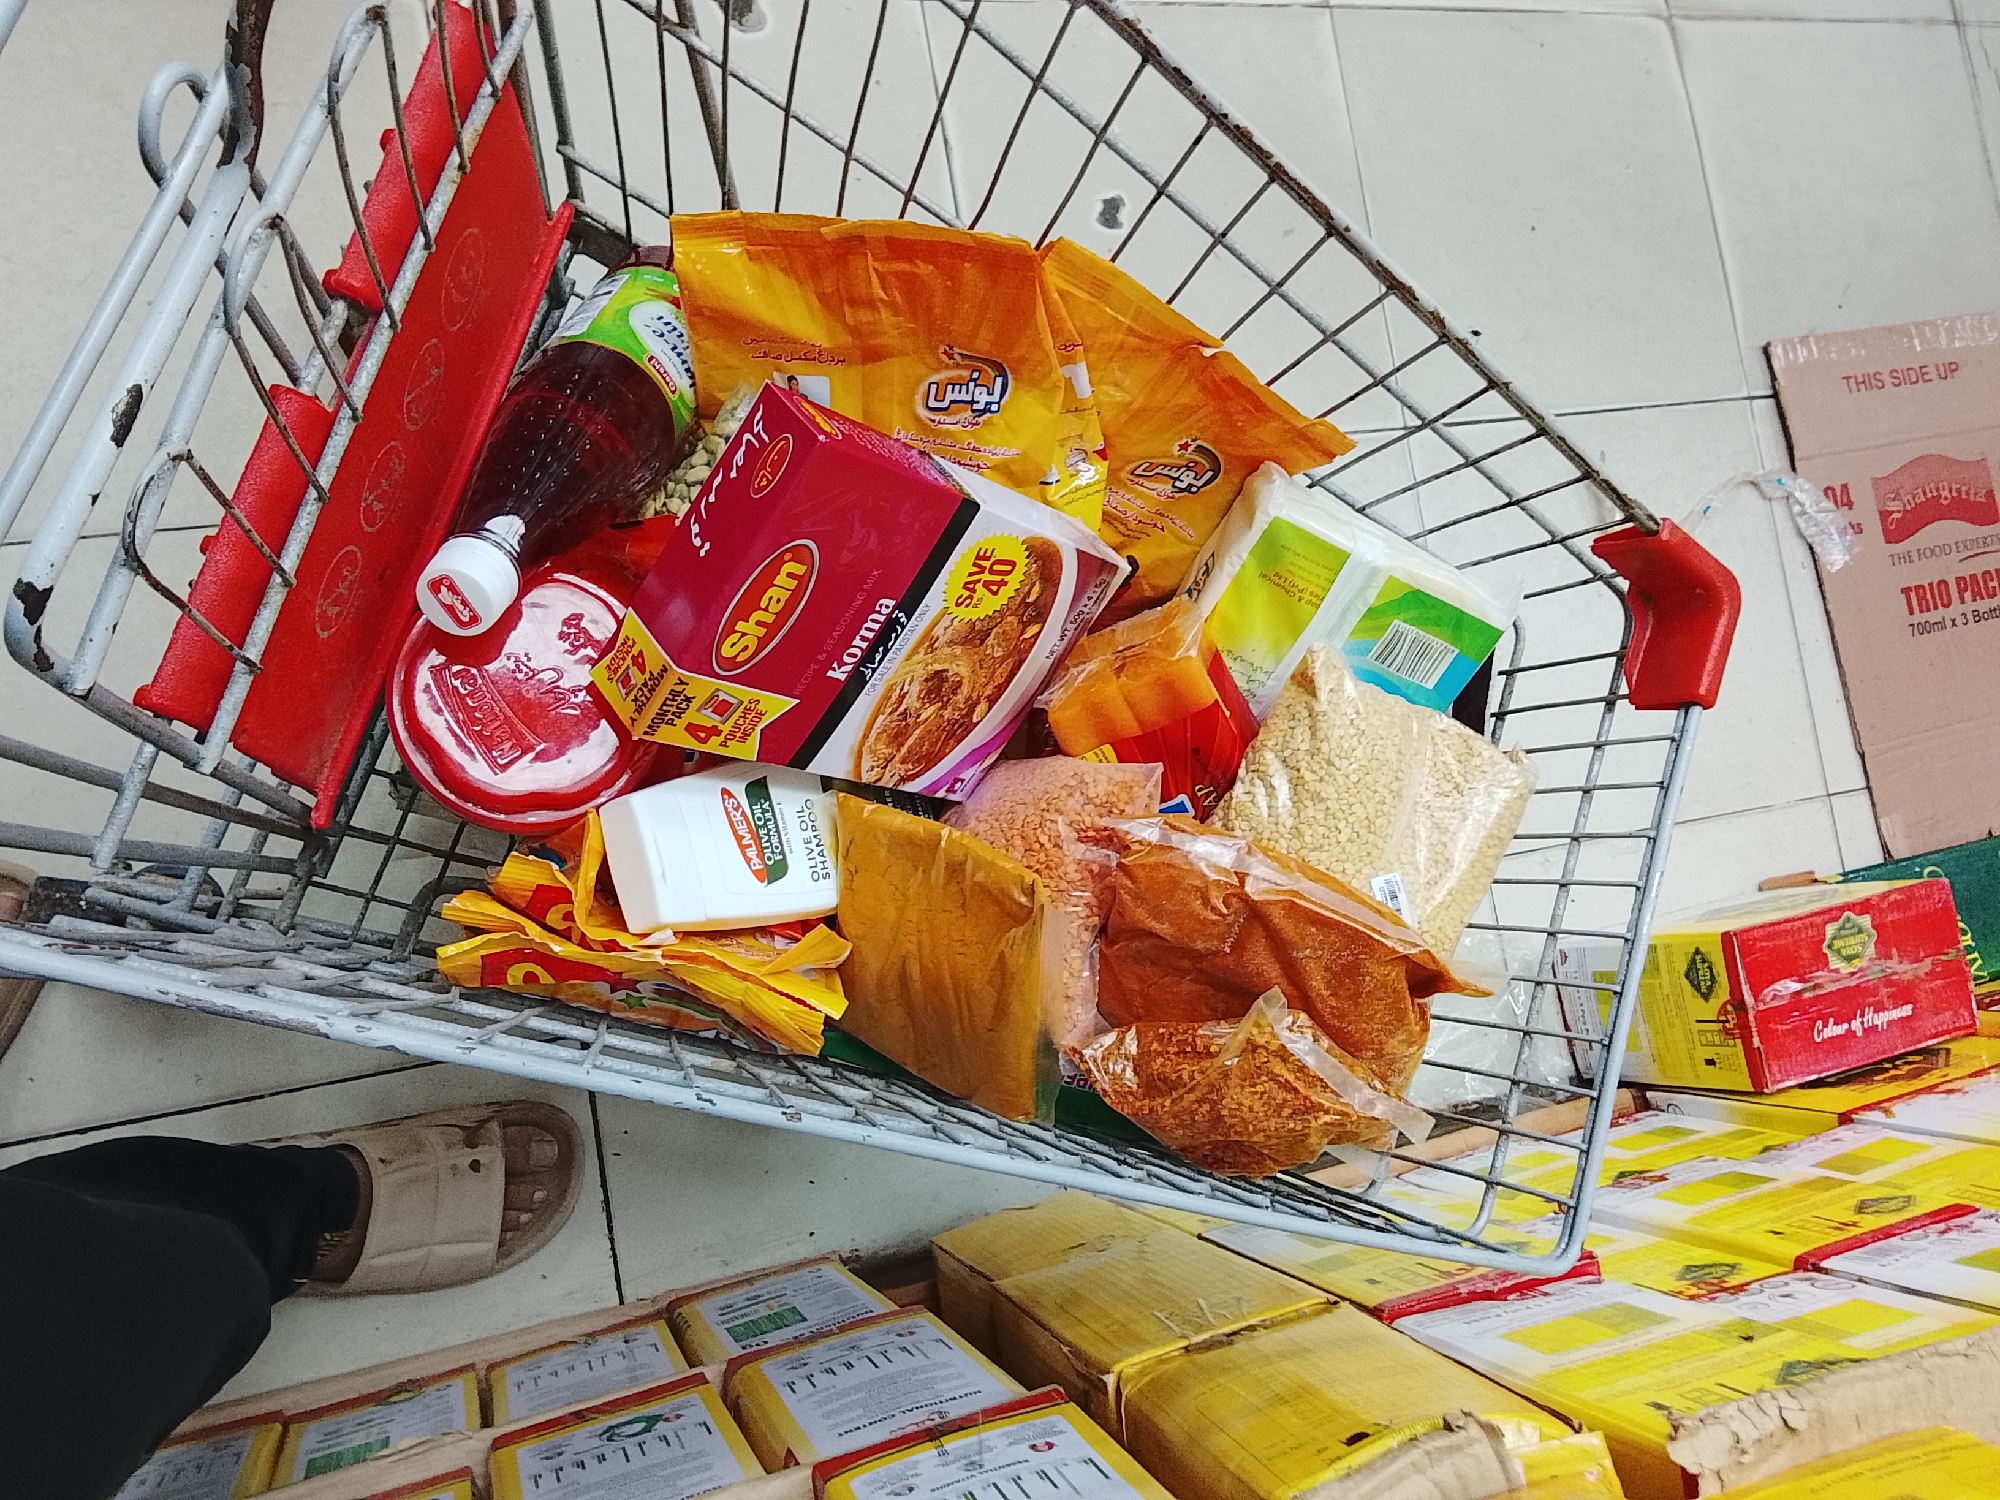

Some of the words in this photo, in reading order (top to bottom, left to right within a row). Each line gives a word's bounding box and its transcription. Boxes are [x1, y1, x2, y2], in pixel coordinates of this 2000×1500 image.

[650, 359, 677, 392] Qarshi
[1842, 372, 1885, 393] THIS
[1890, 365, 1933, 388] SIDE
[1936, 361, 1960, 380] UP
[1884, 479, 1988, 529] Shangrila
[953, 544, 995, 609] SAVE
[980, 557, 1020, 596] 40
[1889, 549, 1915, 567] THE
[1917, 543, 1952, 561] FOOD
[721, 559, 807, 662] Shan
[1901, 578, 1952, 616] TRIO
[792, 660, 821, 698] RECIPE
[816, 650, 827, 662] &
[822, 588, 868, 654] SEASONING
[862, 567, 882, 592] MIX
[825, 590, 897, 686] Korma
[1908, 618, 1948, 638] 700ml
[1960, 612, 1970, 626] 3
[603, 633, 632, 674] INSIDE
[605, 637, 637, 684] POUCHES
[631, 649, 646, 671] 4
[864, 680, 880, 698] FOR
[874, 663, 892, 684] SALE
[886, 654, 897, 666] IN
[892, 620, 920, 658] PAKISTAN
[913, 601, 932, 624] ONLY
[1045, 642, 1060, 661] NET
[626, 663, 670, 729] MONTHLY
[629, 669, 657, 707] PACK
[642, 674, 690, 741] MONTHLY
[451, 667, 521, 763] National
[663, 689, 697, 731] PACK
[718, 697, 761, 749] POUCHES
[735, 704, 768, 748] INSIDE
[684, 720, 719, 745] 4
[724, 797, 764, 870] PALMER'S
[753, 803, 766, 825] OIL
[764, 803, 783, 860] FORMULA
[797, 806, 810, 831] OIL
[760, 828, 774, 864] OLIVE
[804, 800, 831, 879] SHAMPOO
[805, 836, 821, 881] OLIVE
[1814, 1019, 1849, 1042] Colour
[1850, 1013, 1863, 1035] of
[1863, 1002, 1913, 1031] Happiness
